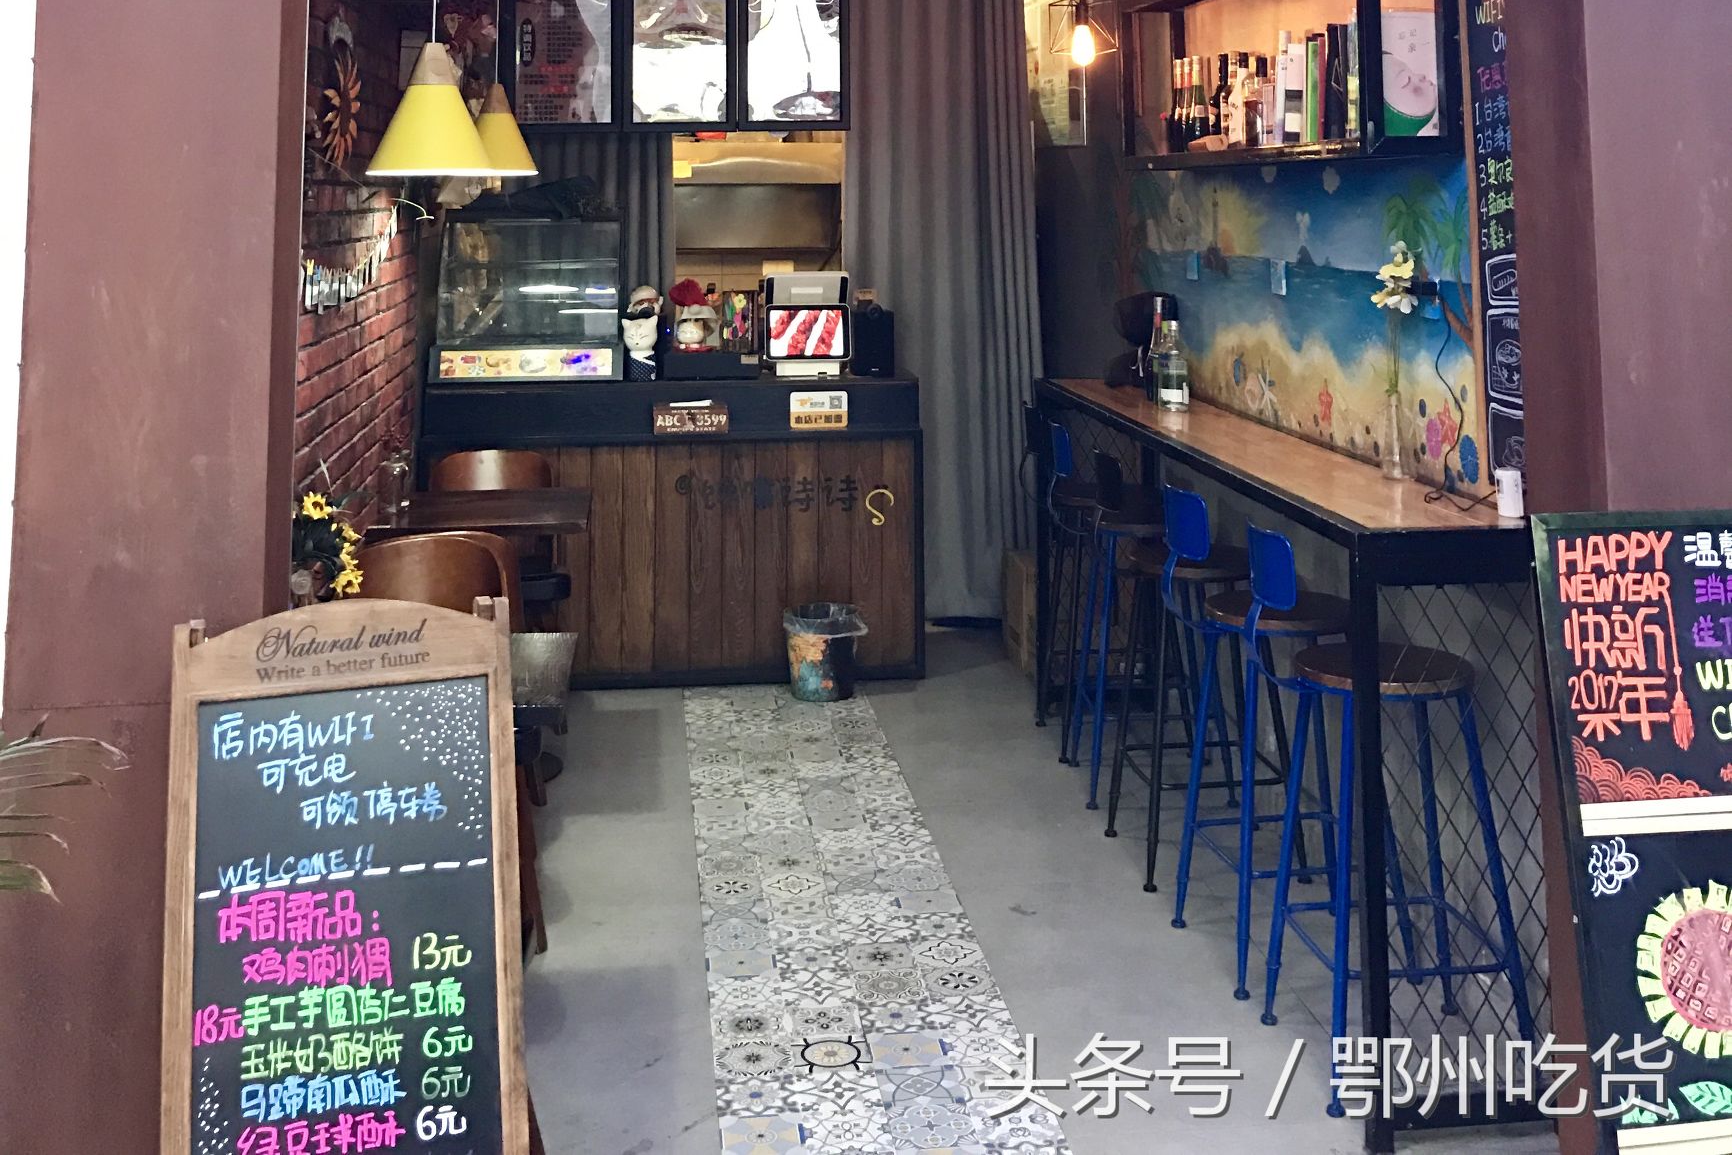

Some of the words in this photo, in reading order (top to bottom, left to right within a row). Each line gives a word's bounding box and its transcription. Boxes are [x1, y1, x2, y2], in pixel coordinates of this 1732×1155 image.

[1558, 531, 1673, 574] HAPPY
[256, 624, 367, 662] Natural
[369, 619, 428, 647] wind
[256, 665, 306, 684] Write
[312, 667, 321, 678] a
[326, 658, 374, 676] better
[380, 650, 431, 669] future
[257, 752, 357, 793] 可充电
[412, 933, 472, 970] 13元
[194, 1004, 246, 1046] 18元
[422, 1025, 473, 1059] 6元
[420, 1066, 471, 1100] 6元
[416, 1104, 467, 1142] 6元
